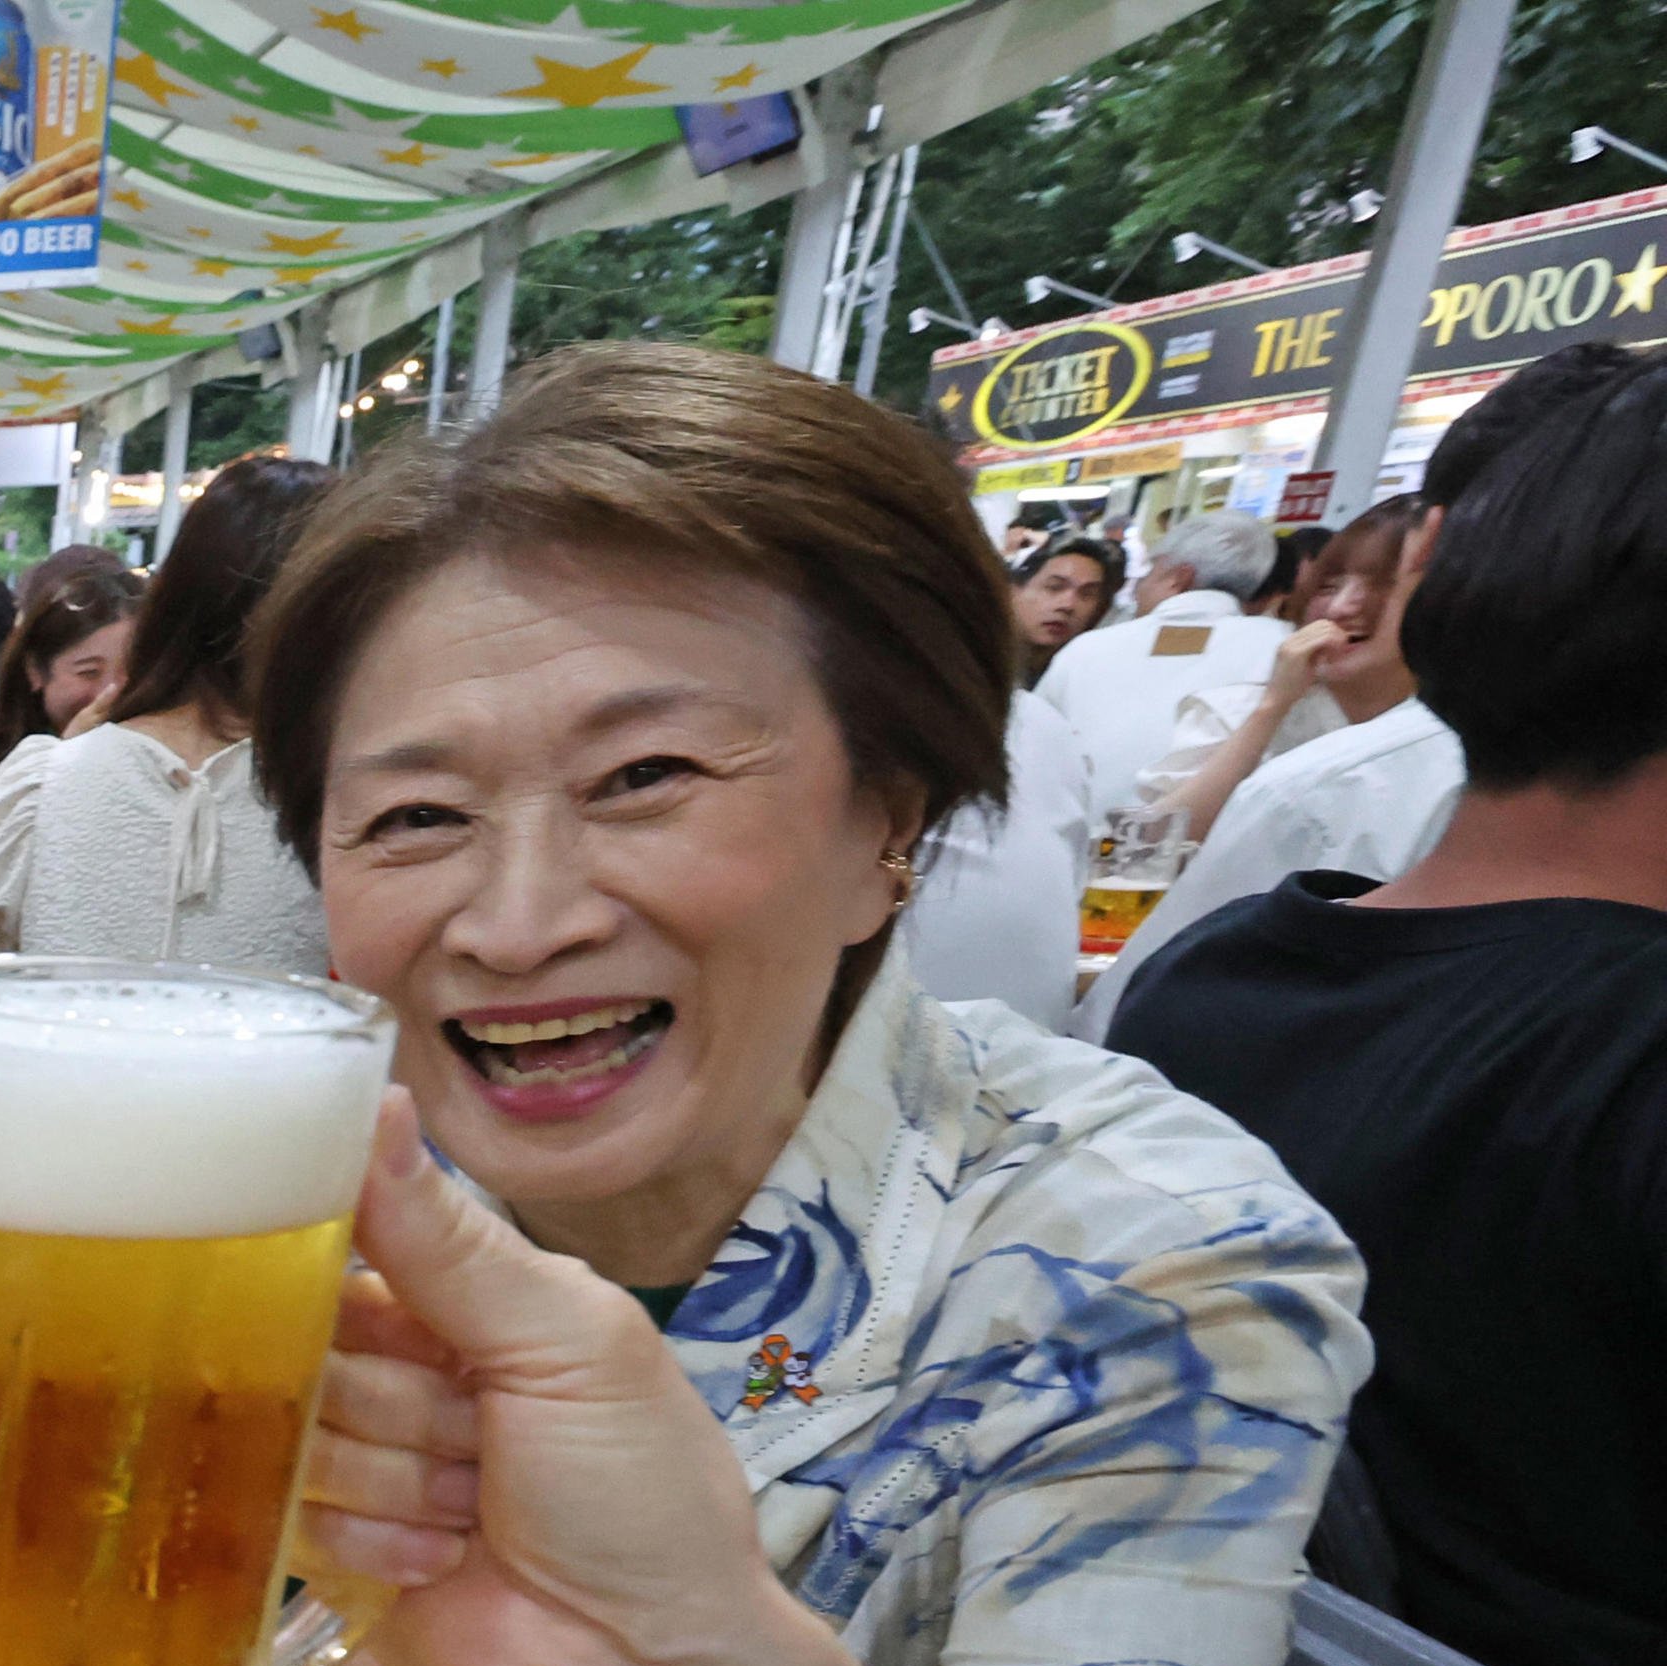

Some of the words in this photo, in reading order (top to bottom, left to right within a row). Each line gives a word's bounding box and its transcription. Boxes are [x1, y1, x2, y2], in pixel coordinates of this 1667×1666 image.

[24, 223, 94, 254] BEER
[1250, 309, 1345, 378] THE
[1420, 256, 1614, 348] PPORO
[1007, 345, 1121, 400] TICKET
